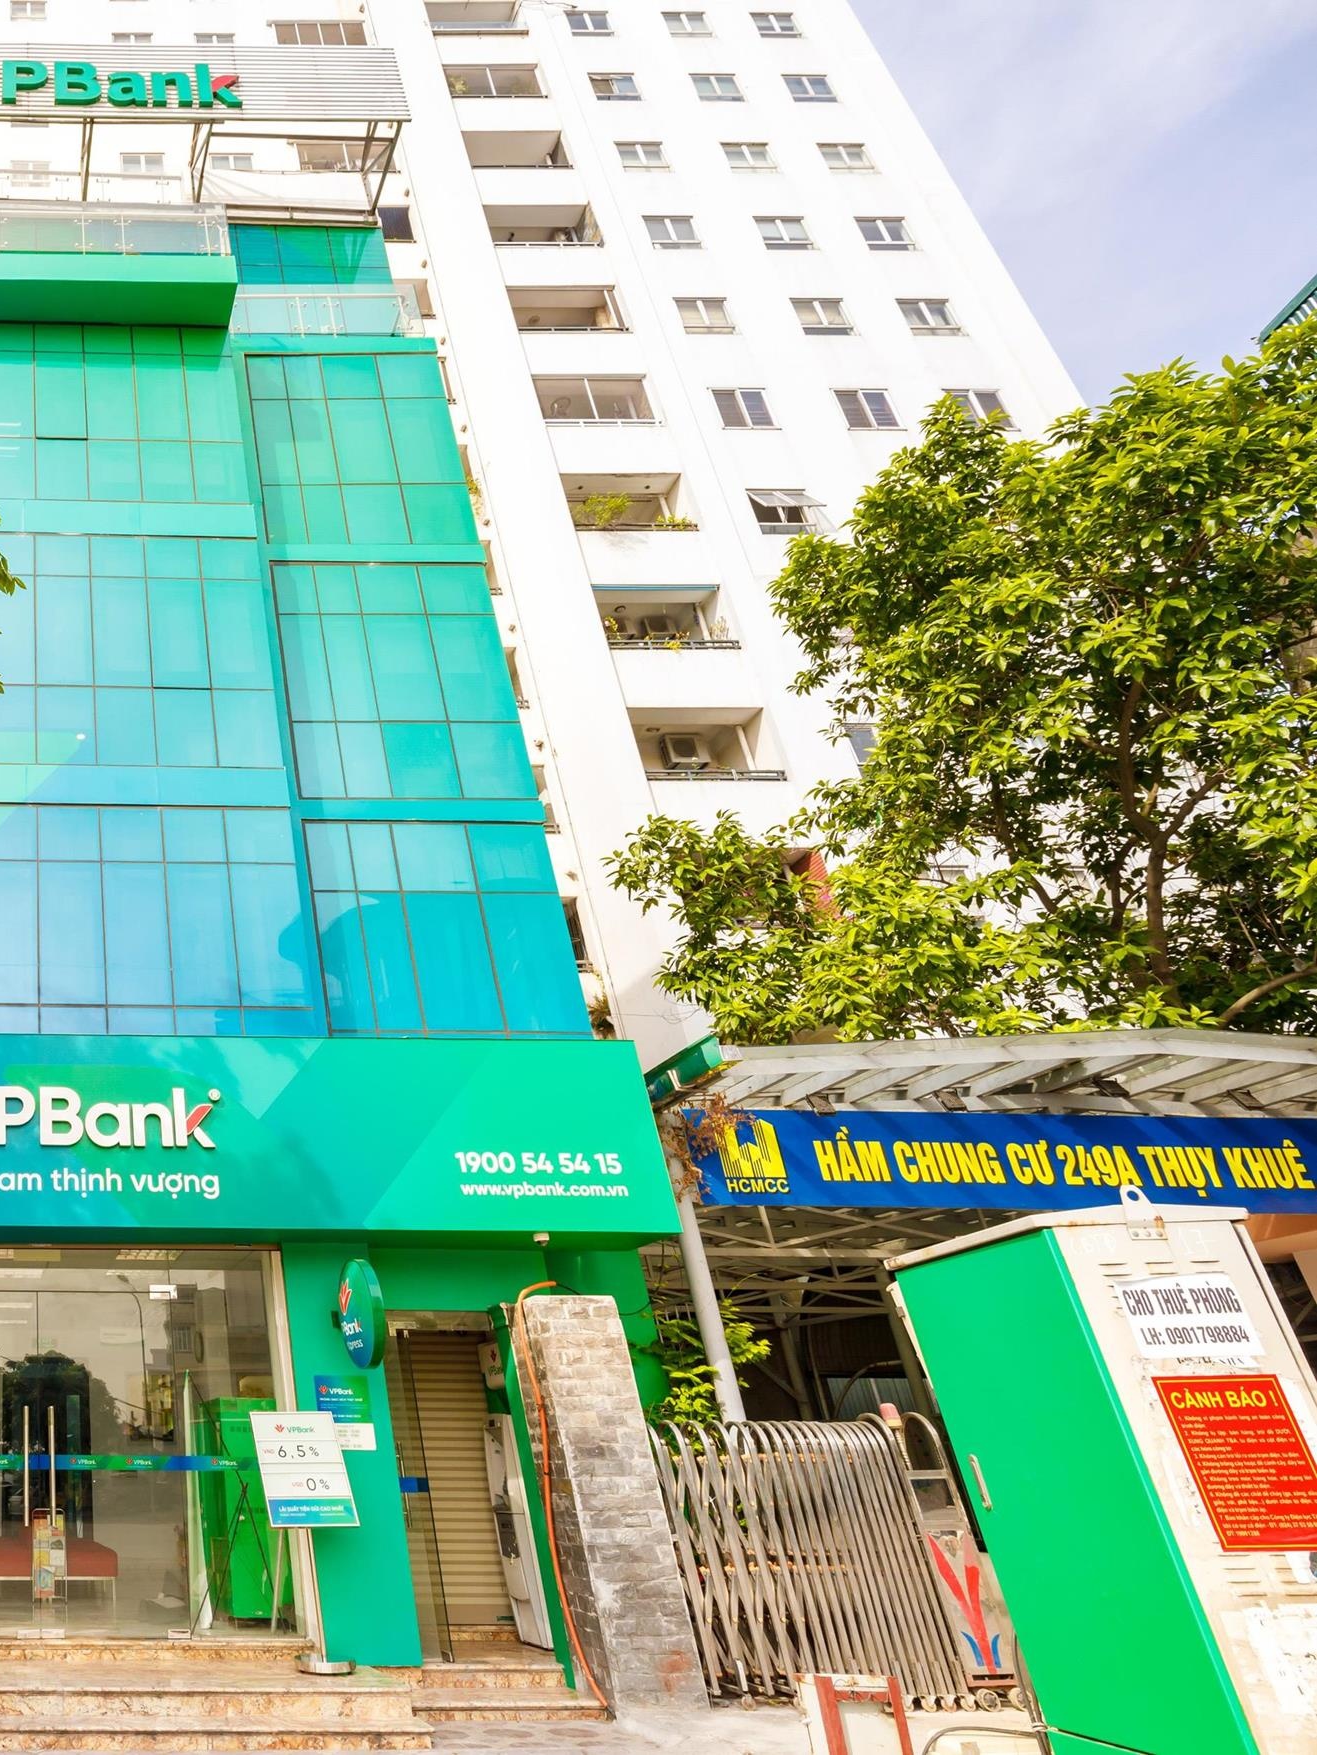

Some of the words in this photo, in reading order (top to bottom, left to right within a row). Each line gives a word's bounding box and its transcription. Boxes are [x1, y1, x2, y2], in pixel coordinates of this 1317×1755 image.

[454, 1151, 516, 1173] 1900
[521, 1152, 554, 1174] 54
[558, 1153, 591, 1174] 54
[594, 1153, 622, 1174] 15
[813, 1126, 892, 1183] HẦM
[893, 1141, 1007, 1184] CHUNG
[1006, 1140, 1055, 1186] CƯ
[1056, 1144, 1144, 1188] 249A
[1137, 1145, 1223, 1197] THỤY
[1222, 1139, 1316, 1190] KHUÊ
[50, 1168, 123, 1199] thịnh
[130, 1172, 220, 1199] vượng
[460, 1181, 629, 1199] www.vpbank.com.vn
[726, 1178, 790, 1193] HCMCC
[1122, 1289, 1155, 1316] CHO
[1151, 1282, 1193, 1315] THUÊ
[1189, 1281, 1243, 1314] PHÒNG
[1140, 1327, 1166, 1345] LH:
[1165, 1325, 1250, 1344] 0901798884
[1170, 1388, 1224, 1409] CẢNH
[1225, 1386, 1267, 1408] BÁO
